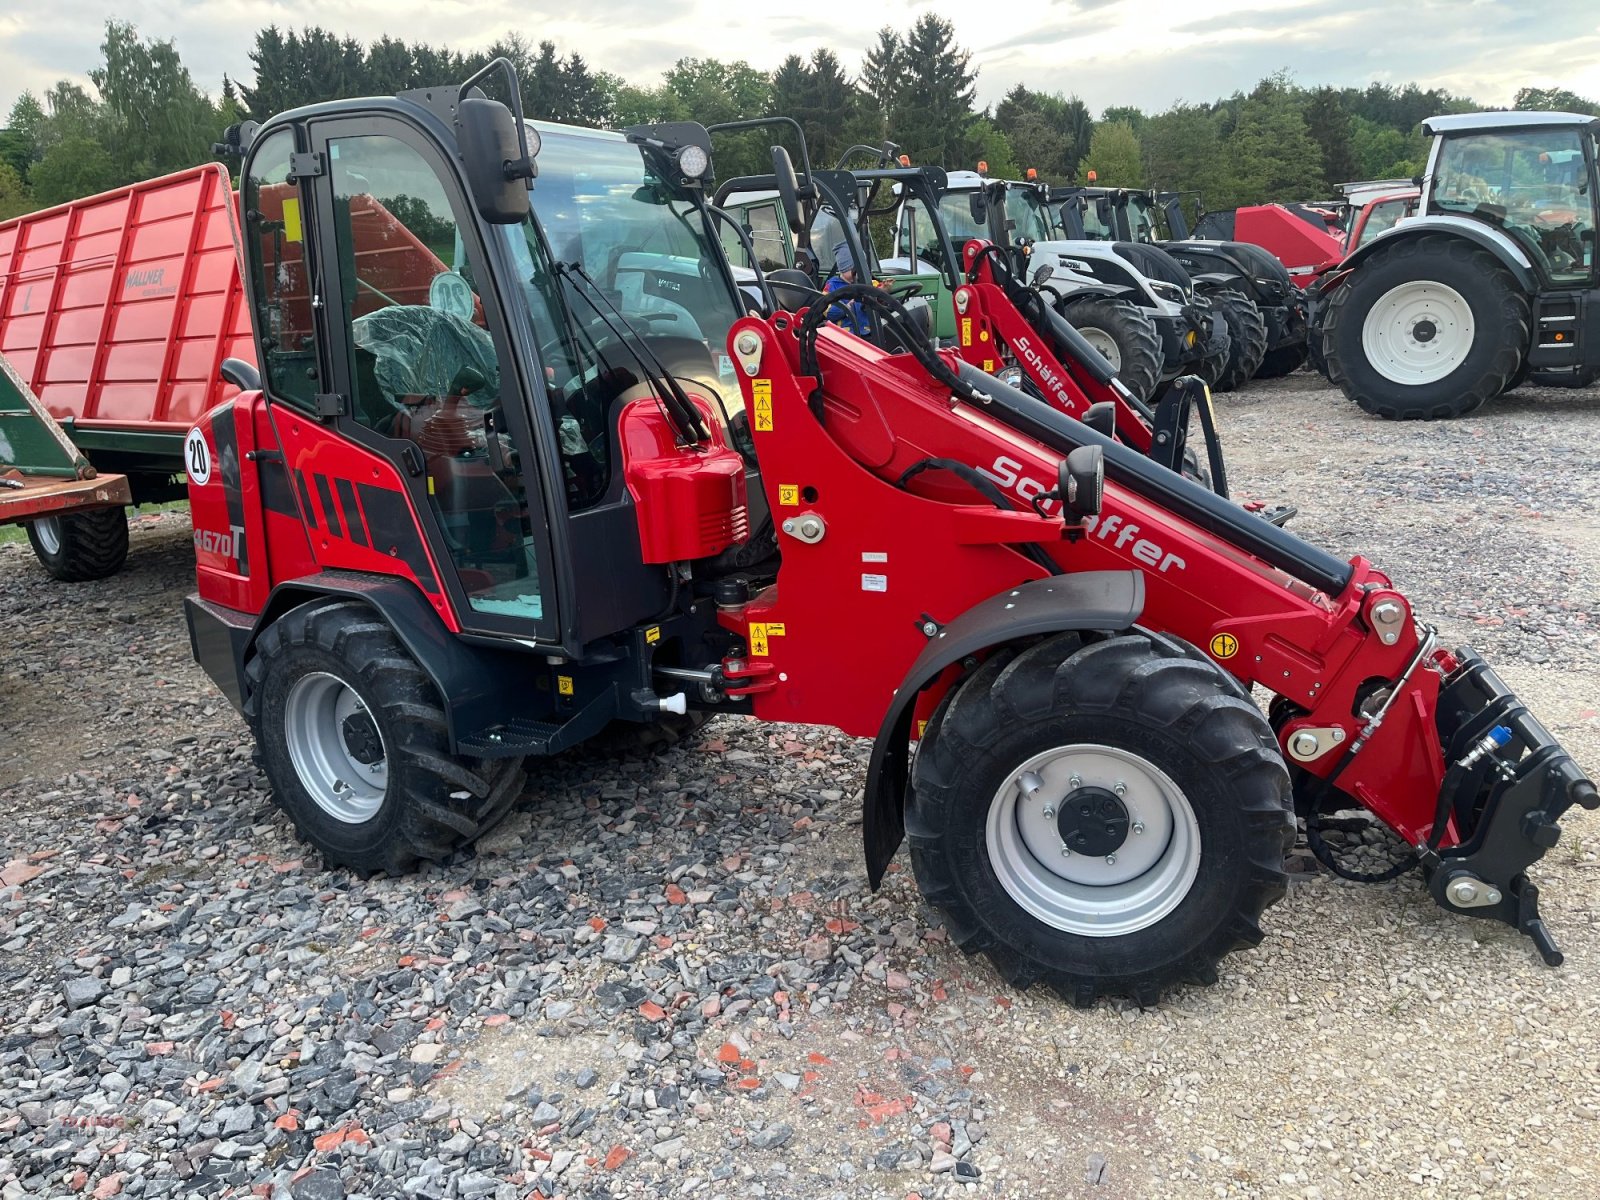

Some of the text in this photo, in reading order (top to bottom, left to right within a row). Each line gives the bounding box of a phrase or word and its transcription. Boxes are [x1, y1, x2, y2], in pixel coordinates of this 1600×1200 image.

[126, 268, 164, 288] WALLNER
[1012, 336, 1075, 409] Schäffer
[190, 439, 207, 475] 20
[975, 455, 1186, 572] Scffer
[193, 524, 245, 560] 4670T
